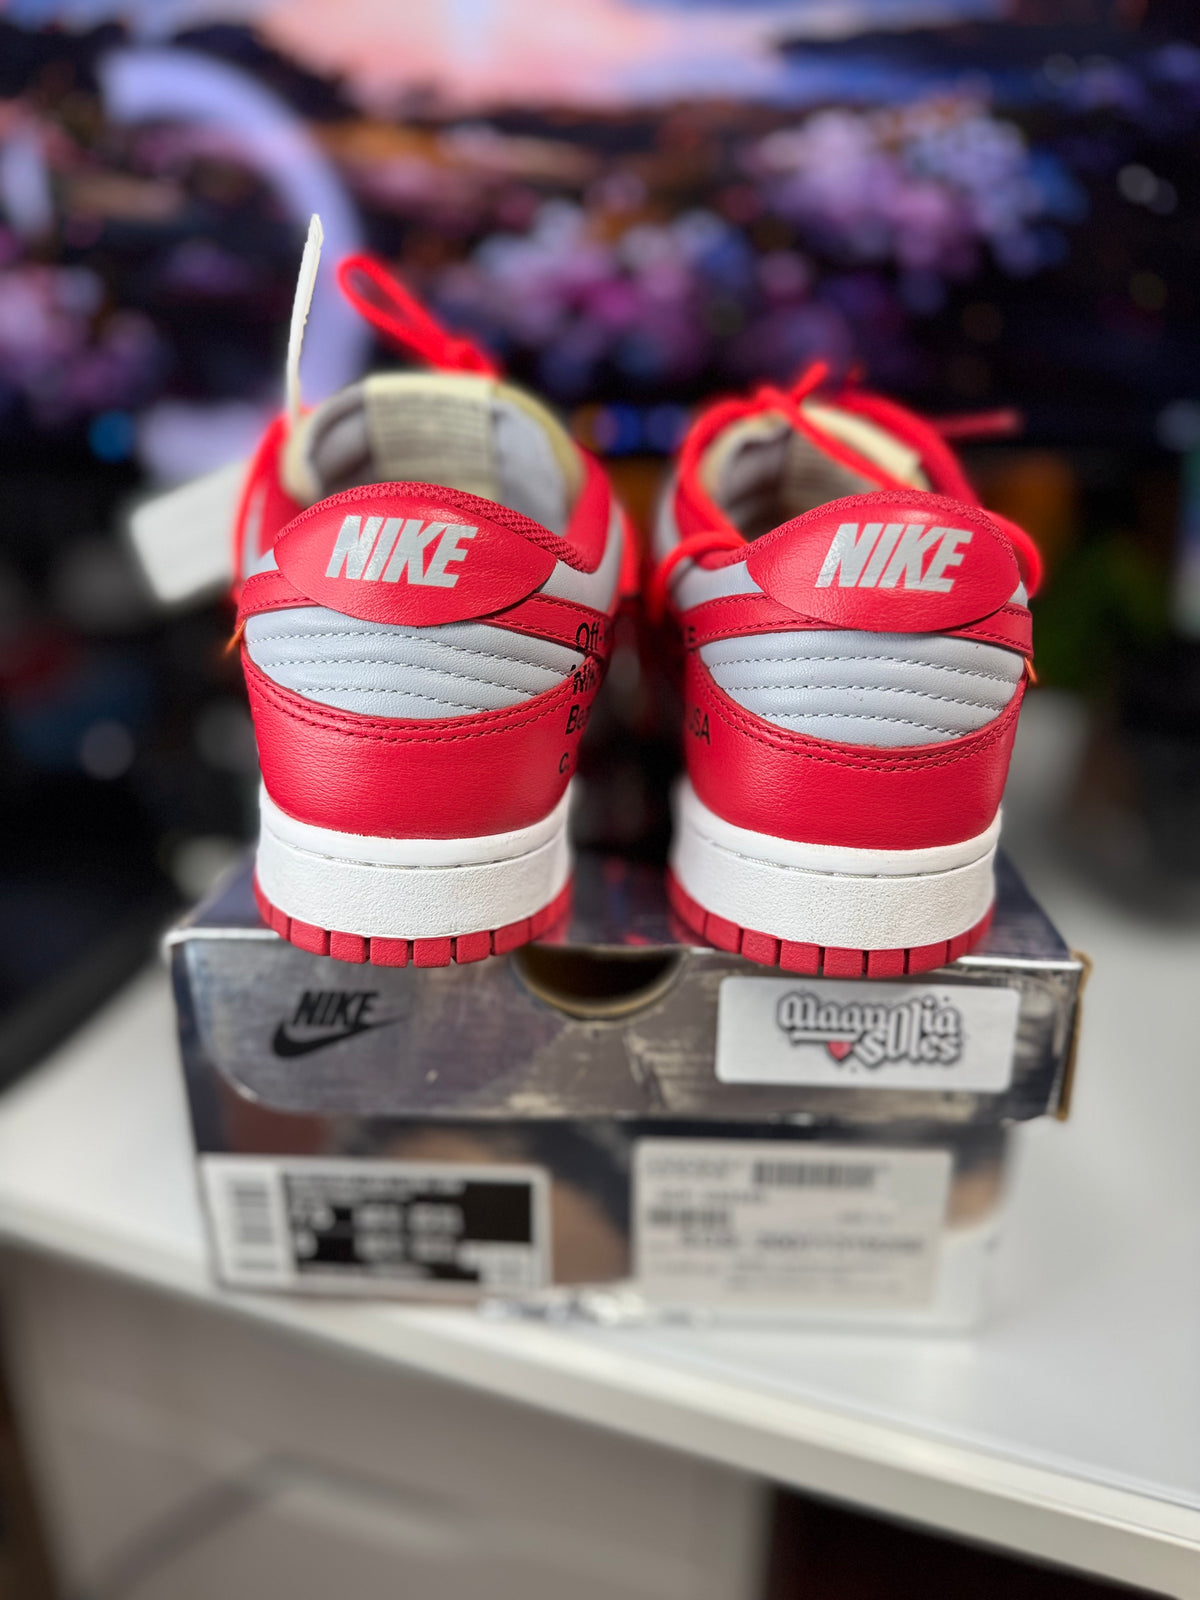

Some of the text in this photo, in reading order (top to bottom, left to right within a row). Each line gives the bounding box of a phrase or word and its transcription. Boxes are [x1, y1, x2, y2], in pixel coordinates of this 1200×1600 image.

[325, 515, 479, 588] NIKE
[814, 523, 974, 593] NIKE
[292, 991, 380, 1028] NIKE
